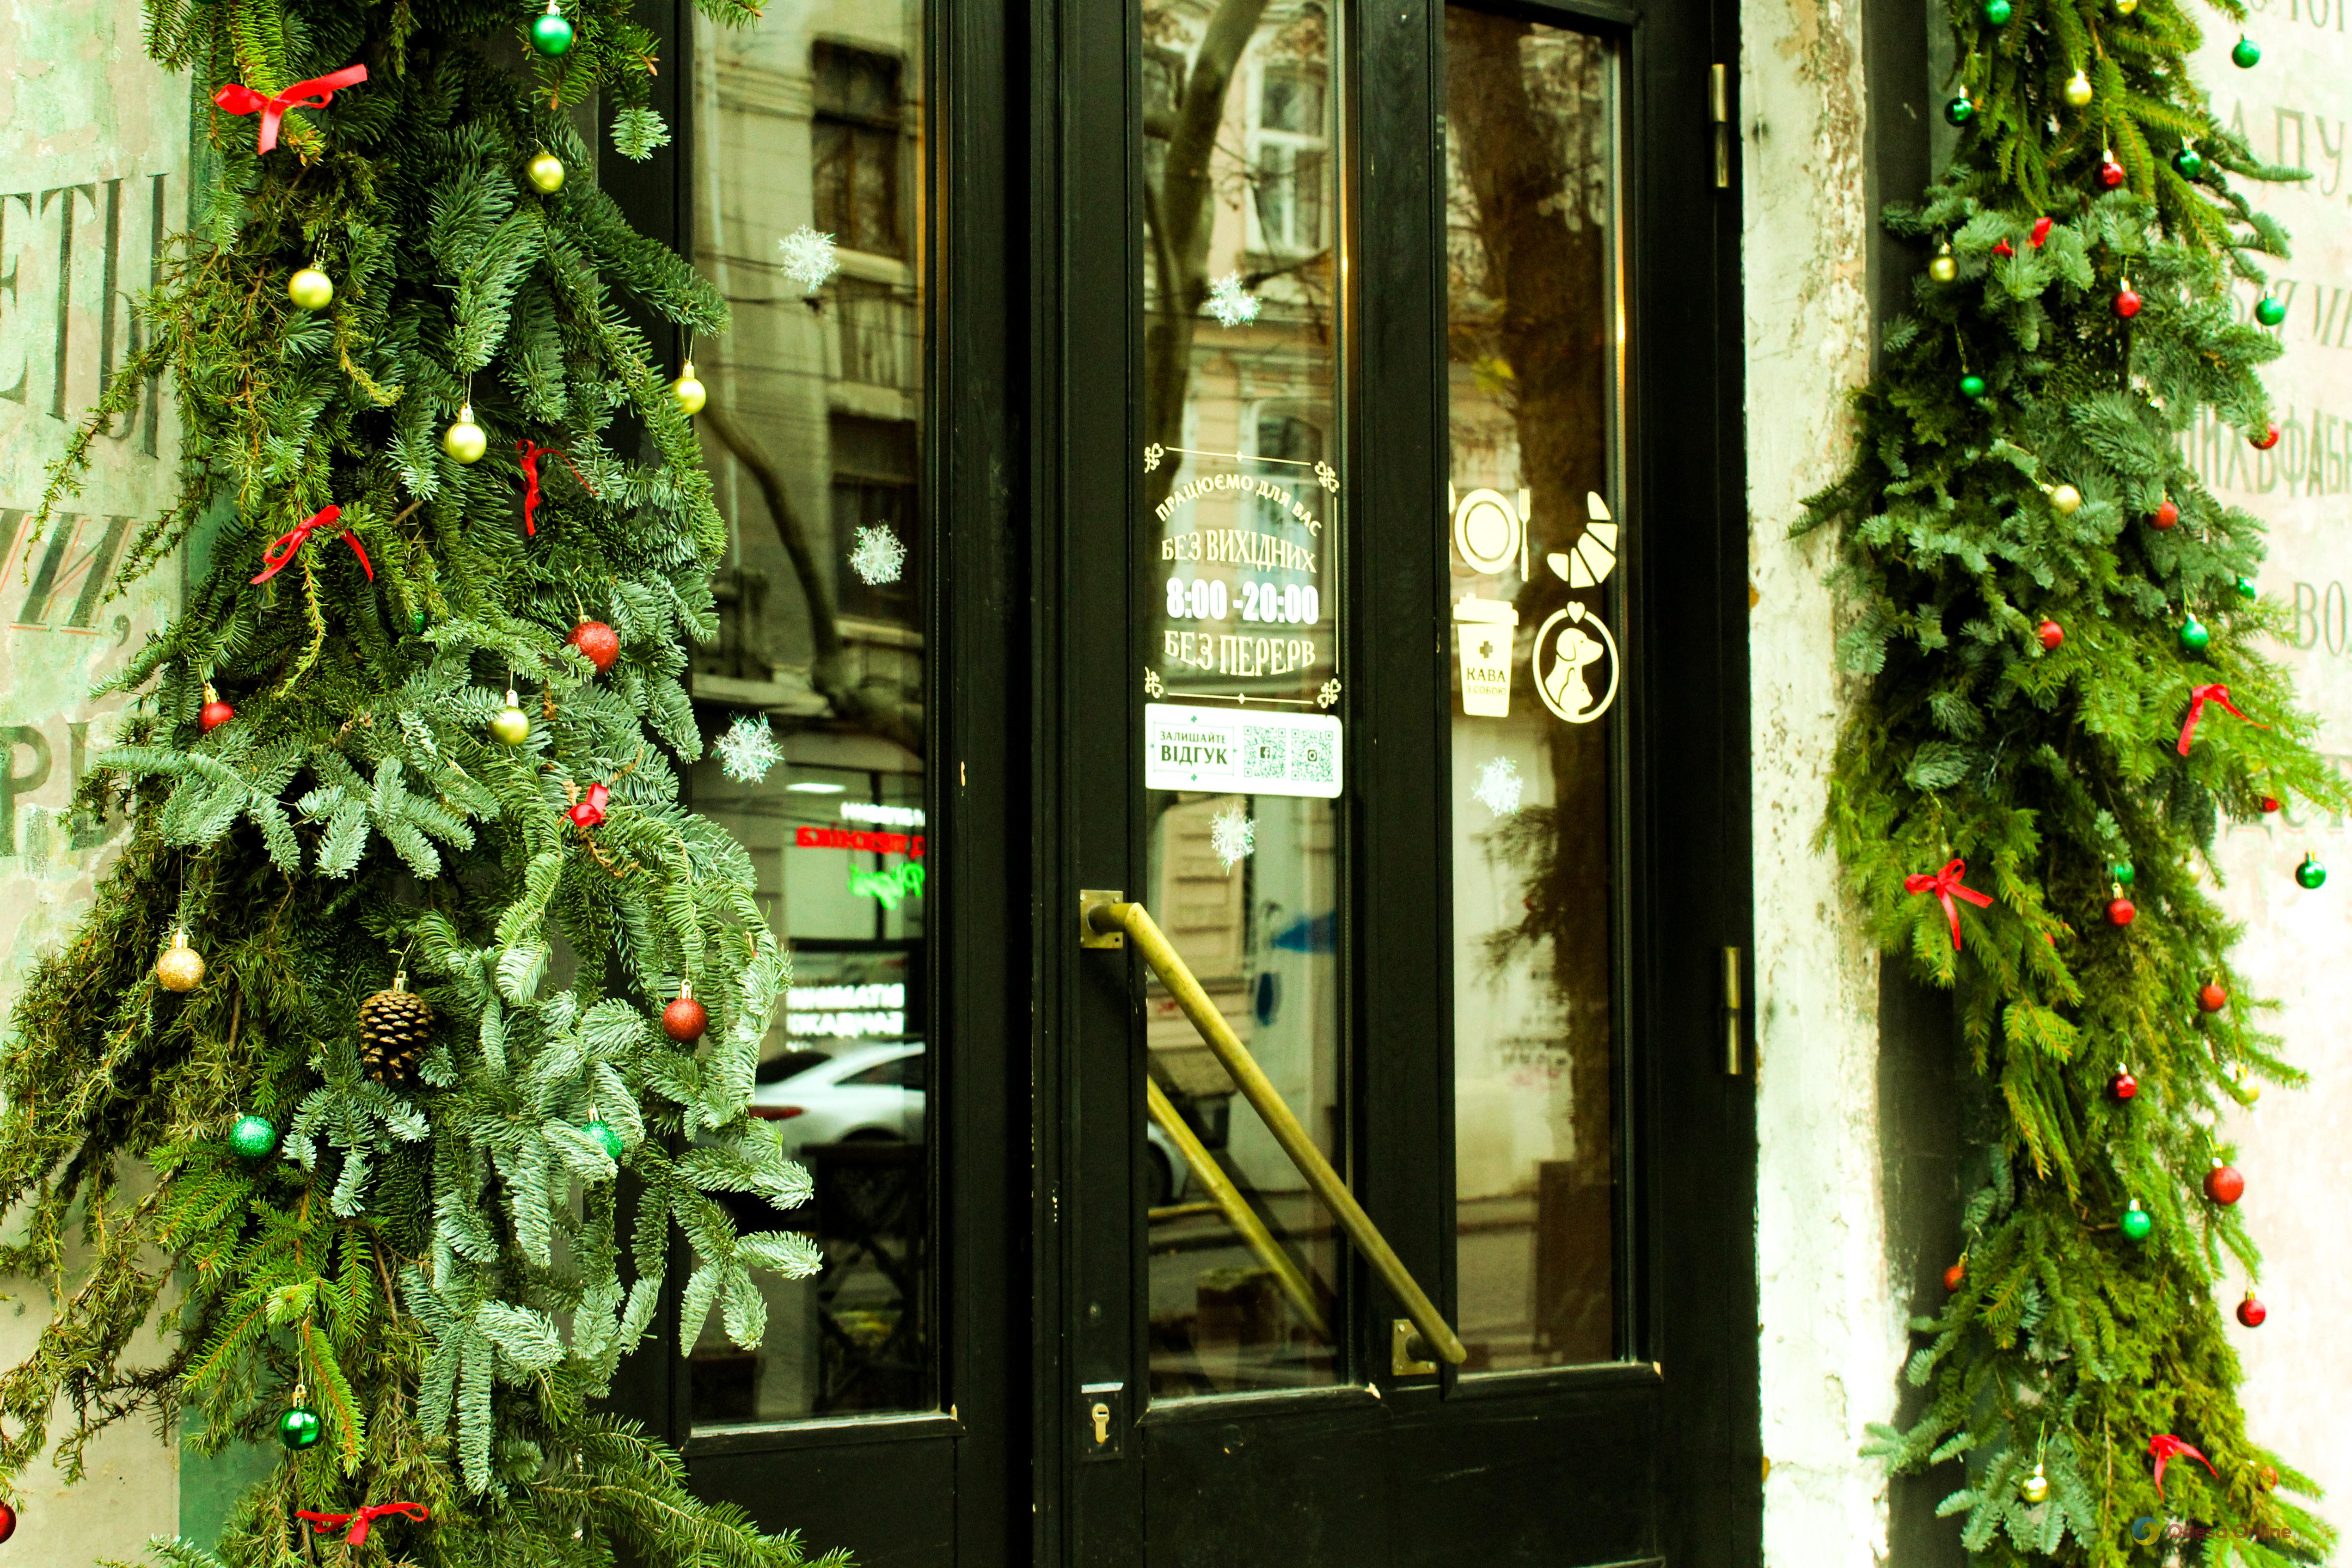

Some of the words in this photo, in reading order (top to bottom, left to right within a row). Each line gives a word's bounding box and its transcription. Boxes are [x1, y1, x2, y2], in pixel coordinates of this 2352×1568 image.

[1155, 474, 1254, 522] ПРАЦЮЄМО
[1256, 479, 1291, 508] ДЛЯ
[1291, 501, 1322, 537] ВАС
[1162, 532, 1202, 560] БЕЗ
[1206, 529, 1317, 573] ВИХІДНИХ
[1166, 577, 1228, 620] 8:00
[1164, 630, 1213, 670] БЕЗ
[1219, 635, 1316, 677] ПЕРЕРВ
[1466, 667, 1506, 683] КАВА
[1160, 730, 1226, 745] ЗАЛИШАЙТЕ
[1161, 744, 1228, 766] ВІДГУК
